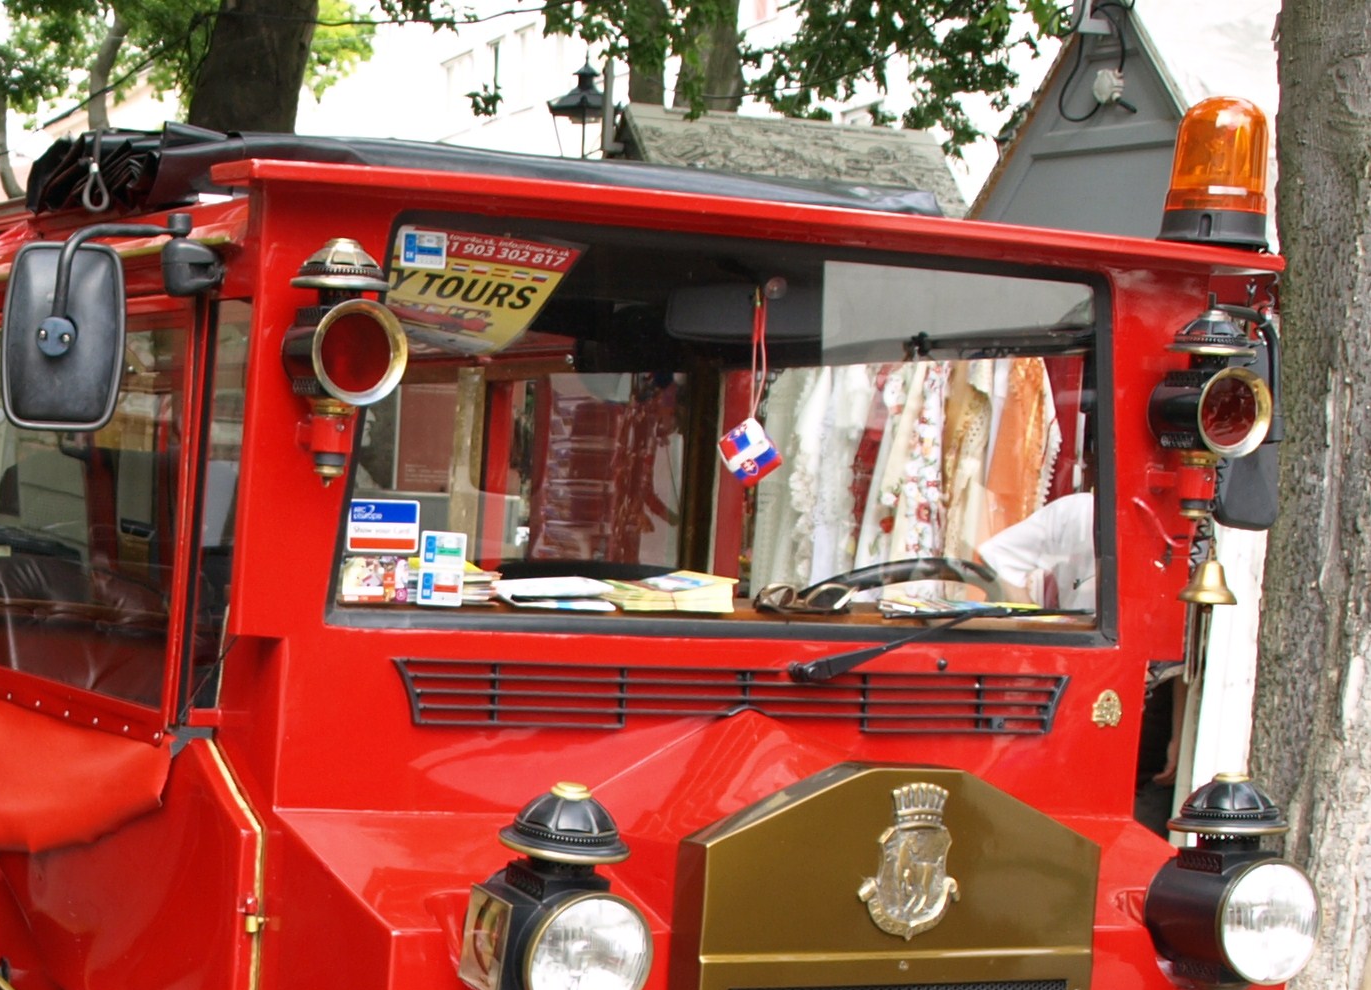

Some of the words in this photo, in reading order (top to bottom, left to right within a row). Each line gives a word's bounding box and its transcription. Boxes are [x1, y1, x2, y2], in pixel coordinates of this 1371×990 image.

[463, 243, 496, 257] 903
[497, 245, 530, 262] 302
[531, 252, 566, 267] 817
[392, 268, 420, 290] Y
[419, 273, 537, 310] TOURS
